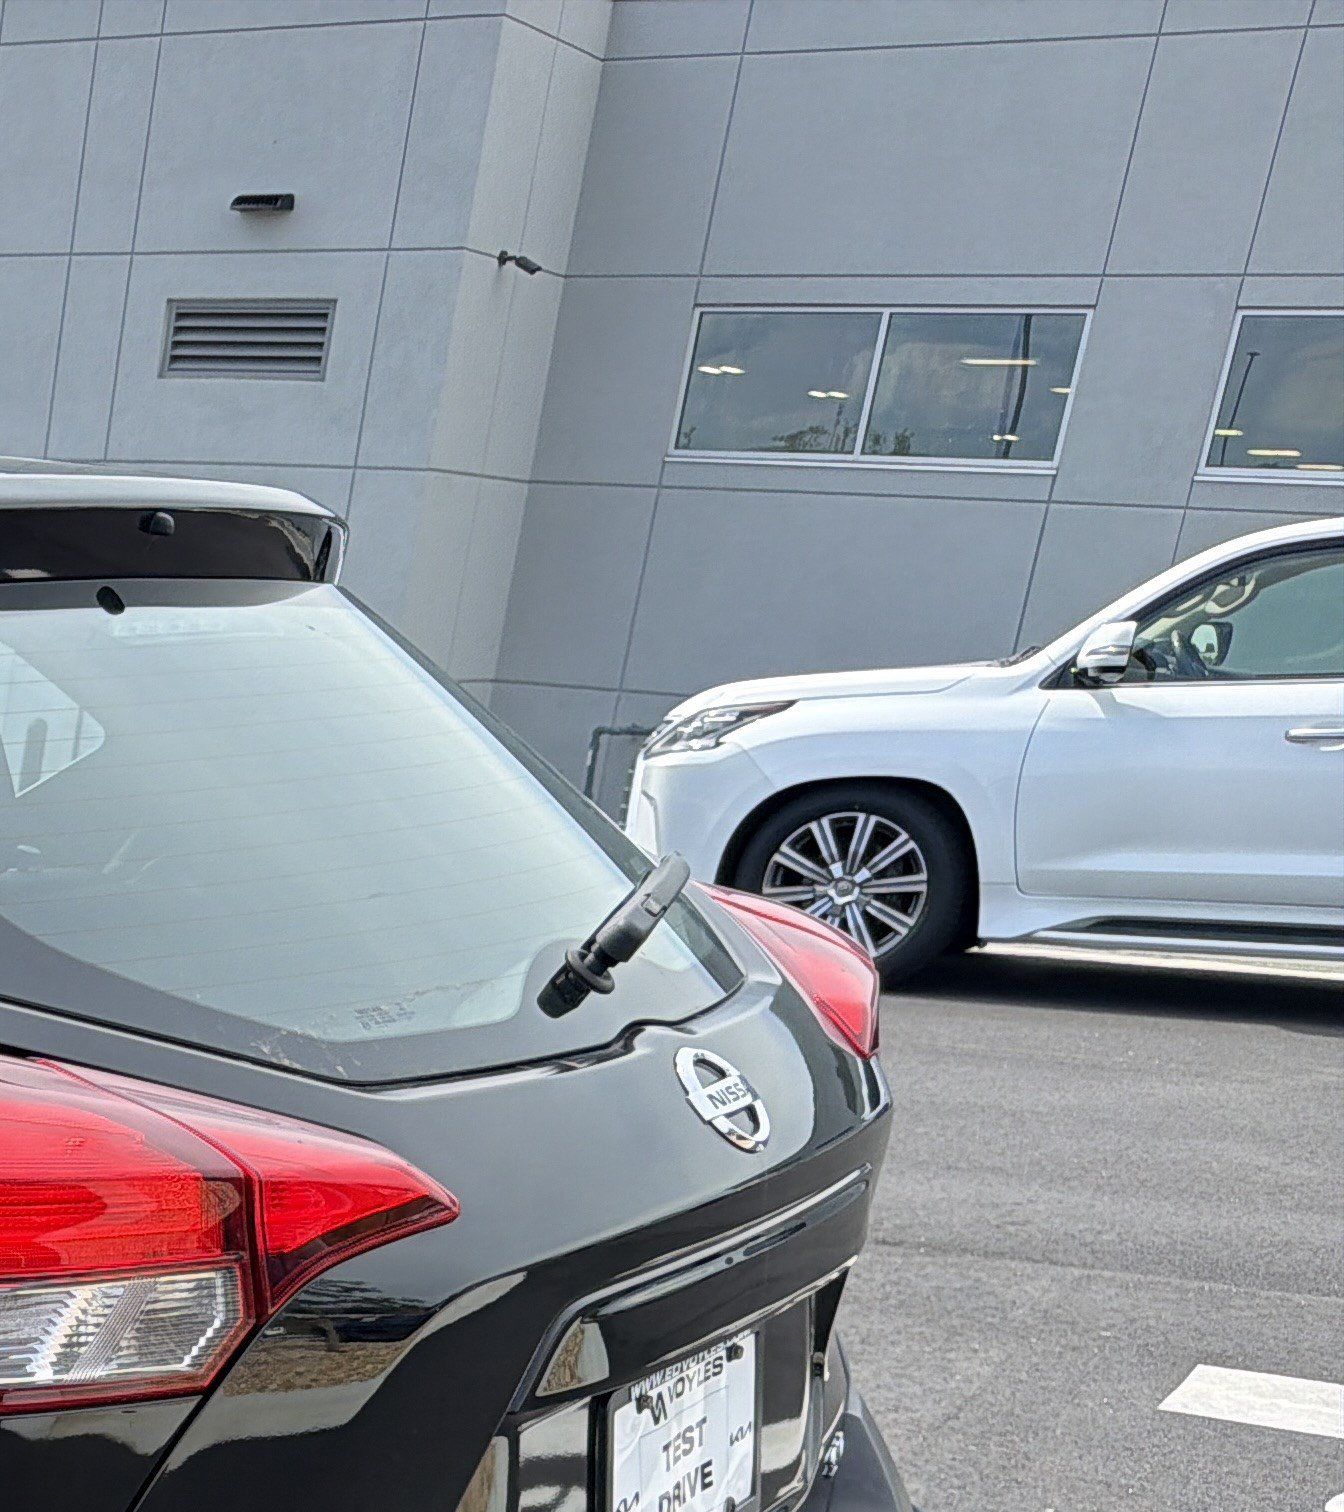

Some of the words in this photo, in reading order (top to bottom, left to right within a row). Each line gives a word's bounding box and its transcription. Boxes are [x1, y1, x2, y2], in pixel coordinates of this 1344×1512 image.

[706, 1082, 748, 1110] NISS
[668, 1355, 724, 1408] VOYLES
[662, 1416, 708, 1473] TEST
